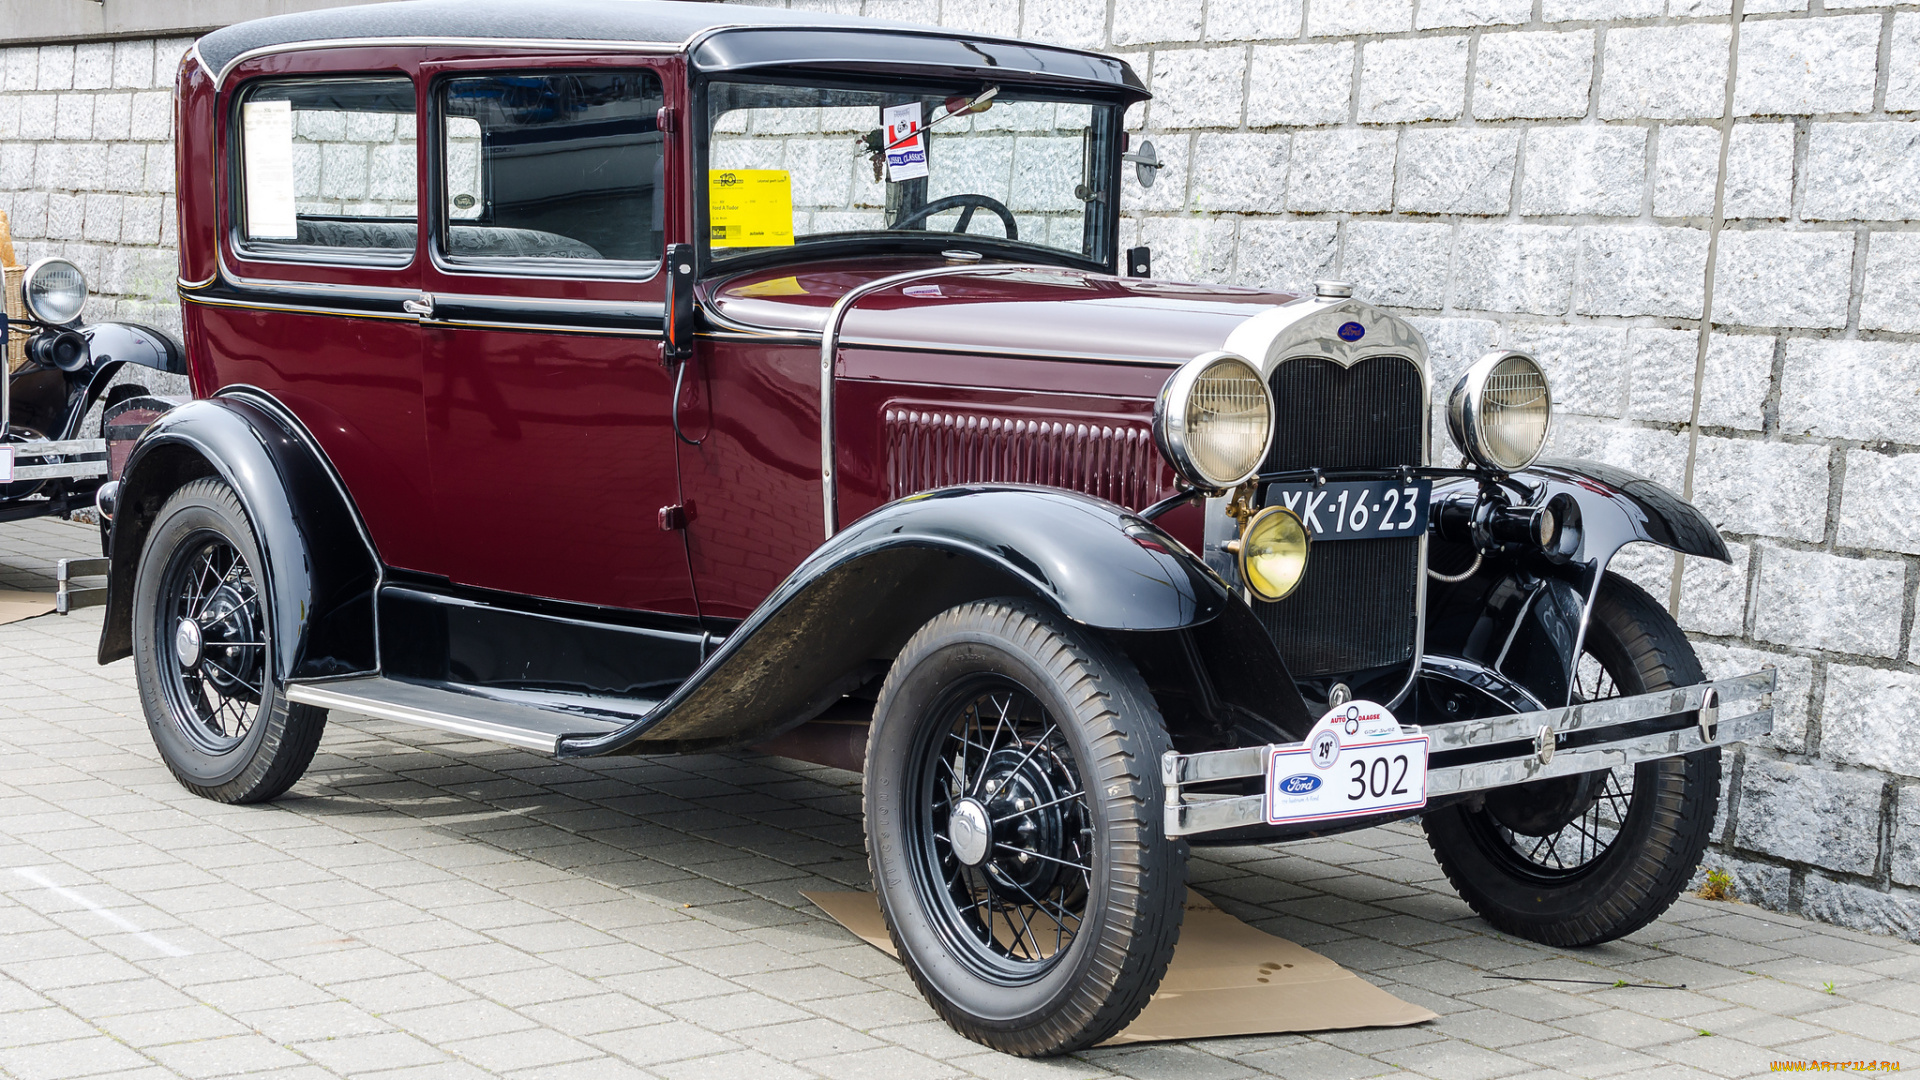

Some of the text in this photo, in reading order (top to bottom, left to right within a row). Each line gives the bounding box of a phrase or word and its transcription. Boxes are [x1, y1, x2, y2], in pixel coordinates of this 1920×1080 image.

[1341, 325, 1362, 336] Ford
[1287, 777, 1314, 791] Ford
[1347, 755, 1408, 801] 302
